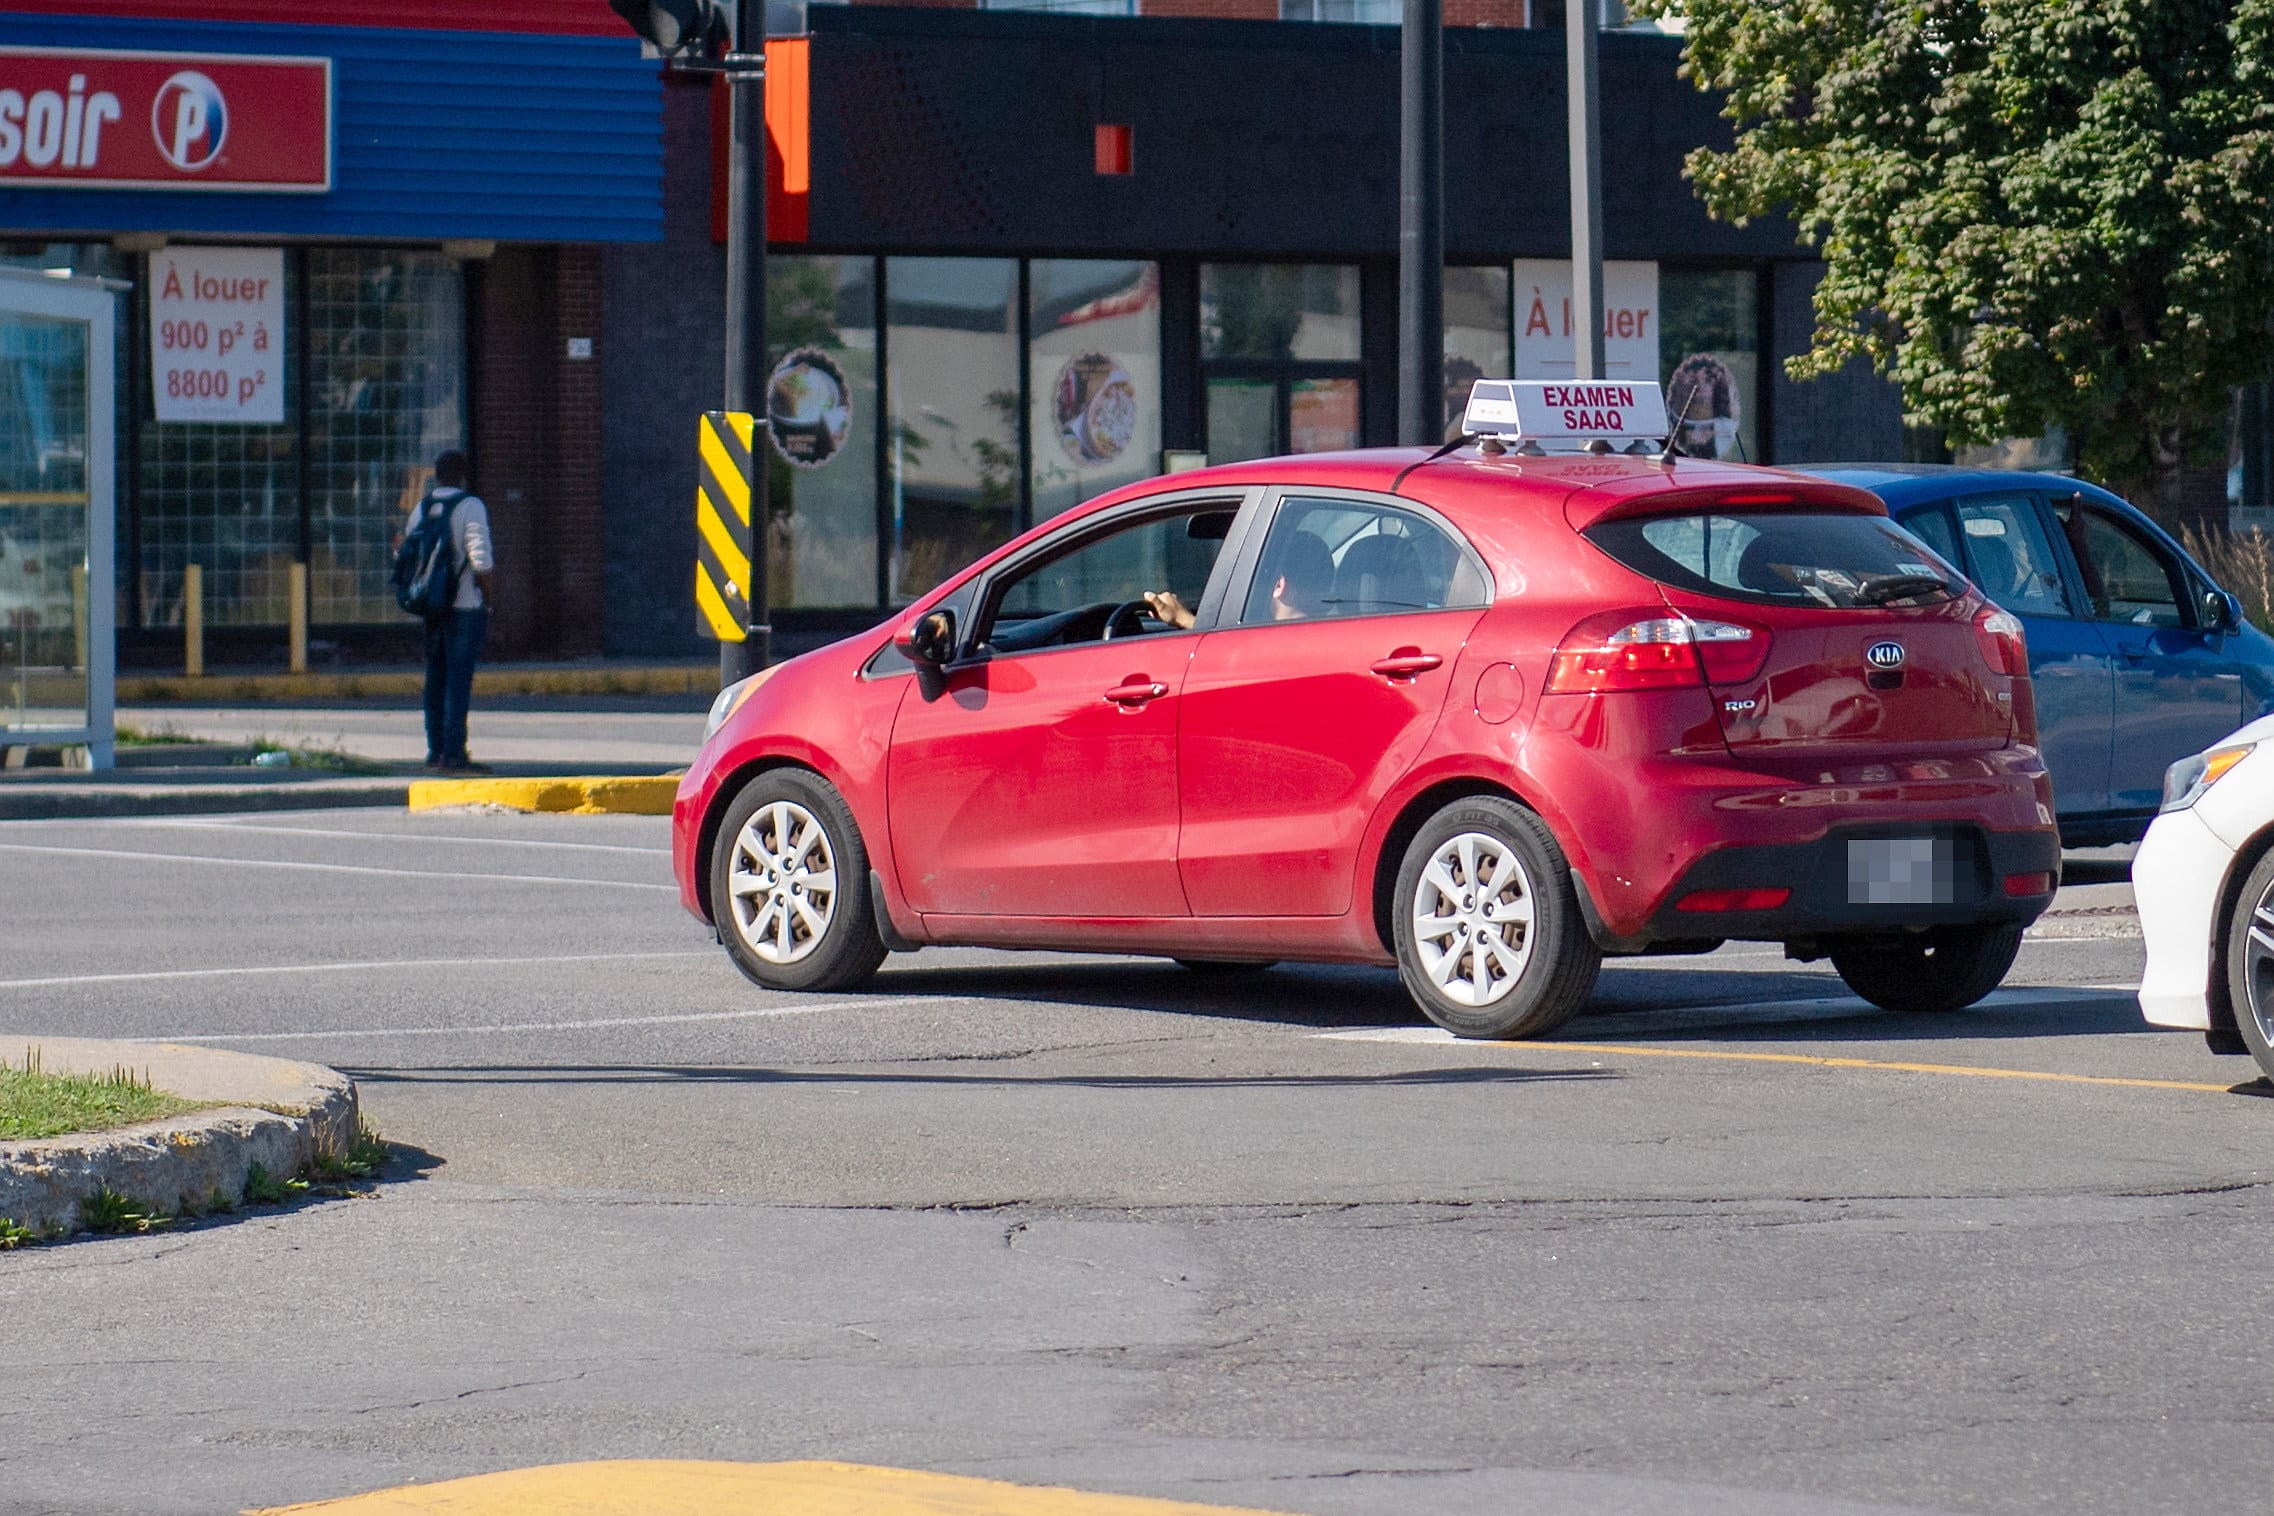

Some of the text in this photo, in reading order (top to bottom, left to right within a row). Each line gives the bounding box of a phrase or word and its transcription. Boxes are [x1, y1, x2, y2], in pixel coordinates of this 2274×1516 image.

[0, 73, 122, 169] soir
[161, 261, 270, 301] À louer
[1526, 286, 1649, 338] À luer
[161, 320, 209, 350] 900
[253, 321, 268, 351] à
[167, 369, 229, 398] 8800
[1543, 386, 1634, 407] EXAMEN
[1564, 409, 1623, 431] SAAQ
[1875, 646, 1901, 662] KIA
[1725, 700, 1755, 710] RIO
